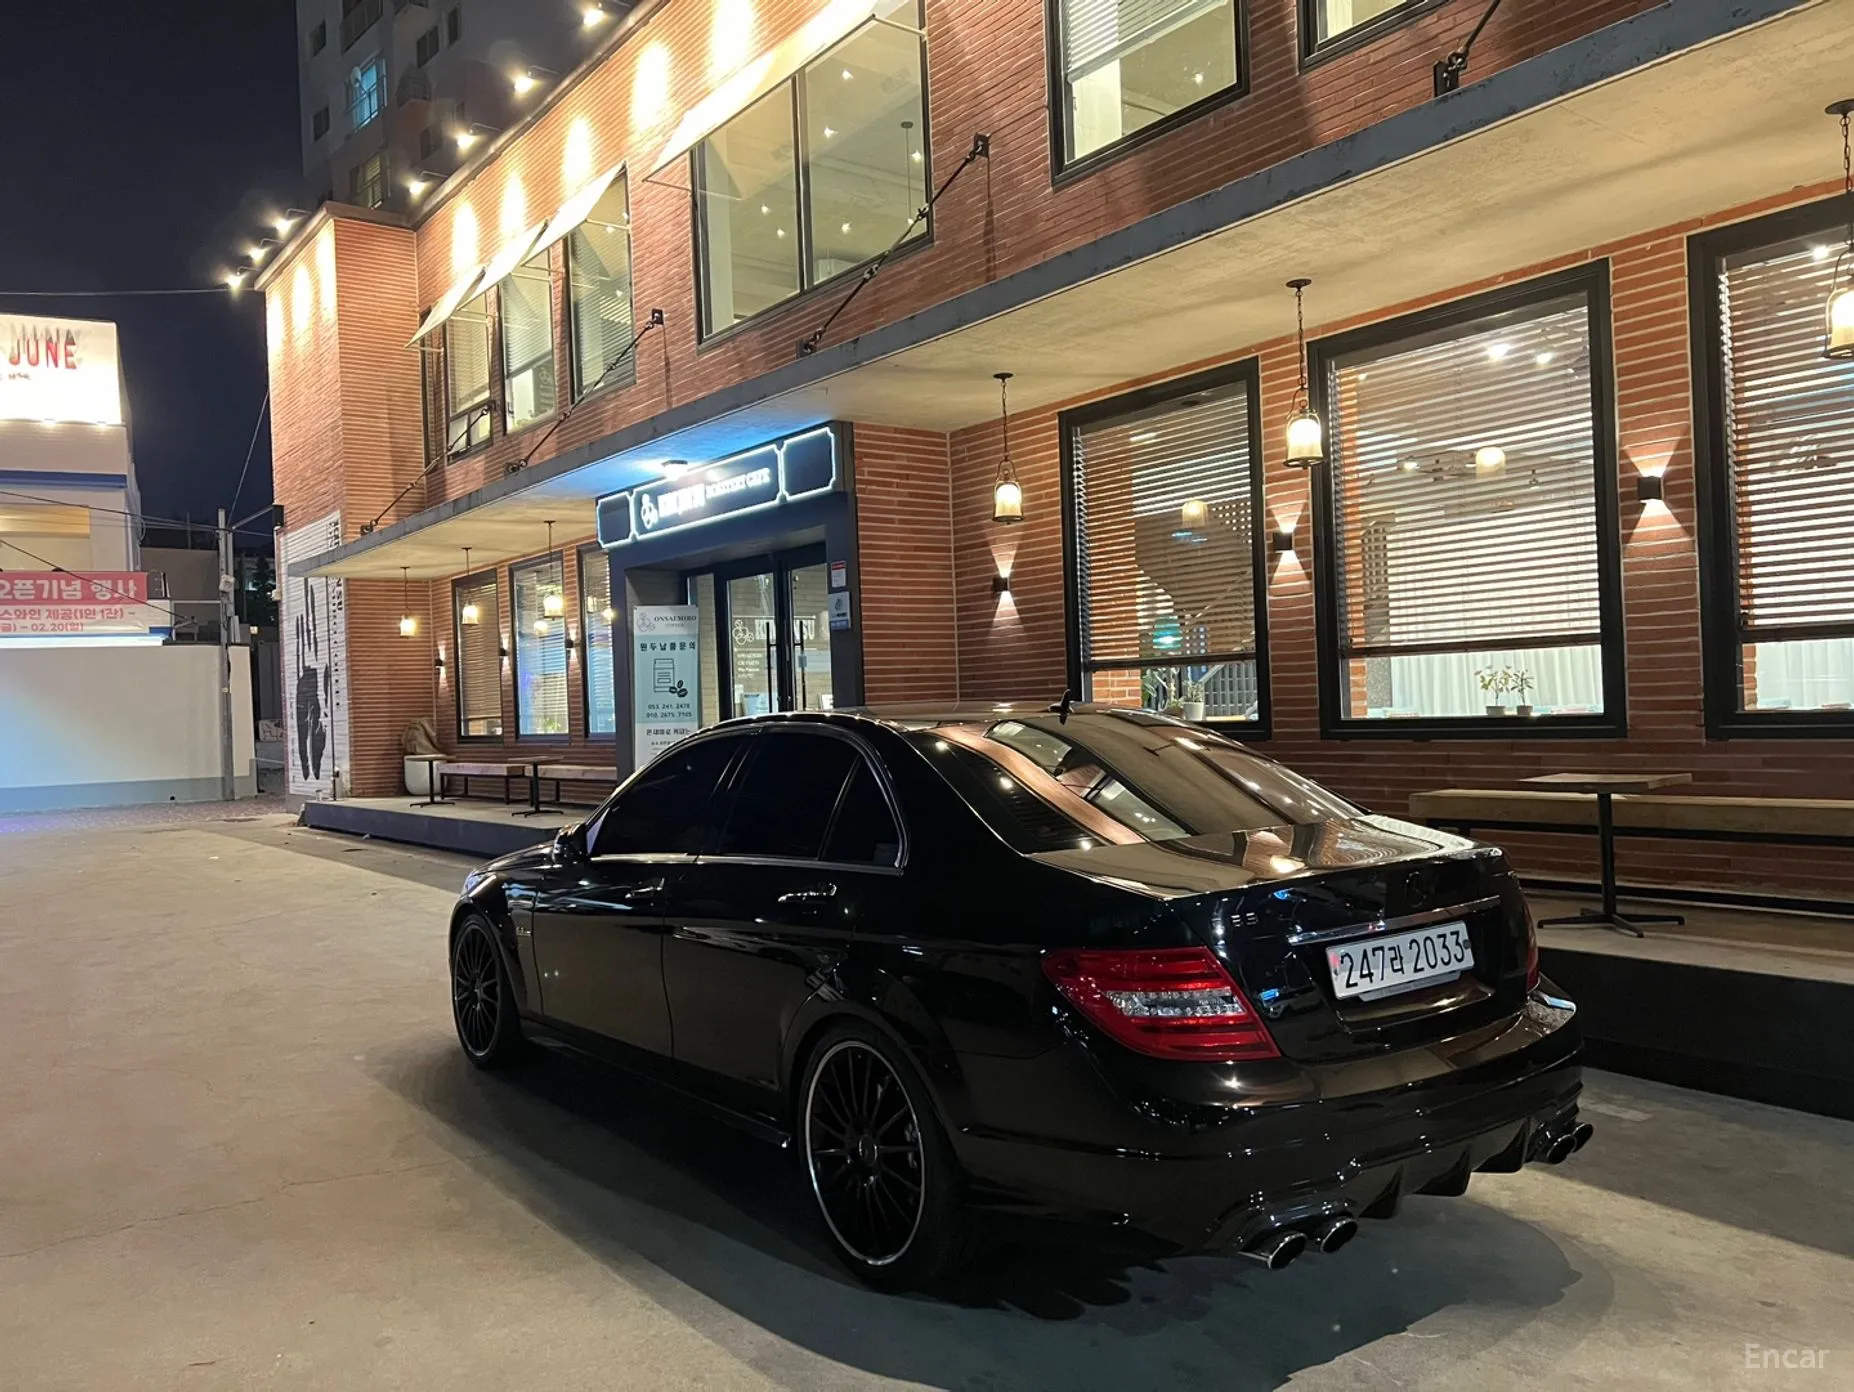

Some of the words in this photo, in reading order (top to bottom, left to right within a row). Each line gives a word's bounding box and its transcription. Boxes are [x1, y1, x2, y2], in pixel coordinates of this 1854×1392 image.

[8, 338, 78, 370] JUNE
[91, 578, 138, 600] 행사
[1340, 944, 1404, 989] 247라
[1408, 930, 1466, 973] 2033
